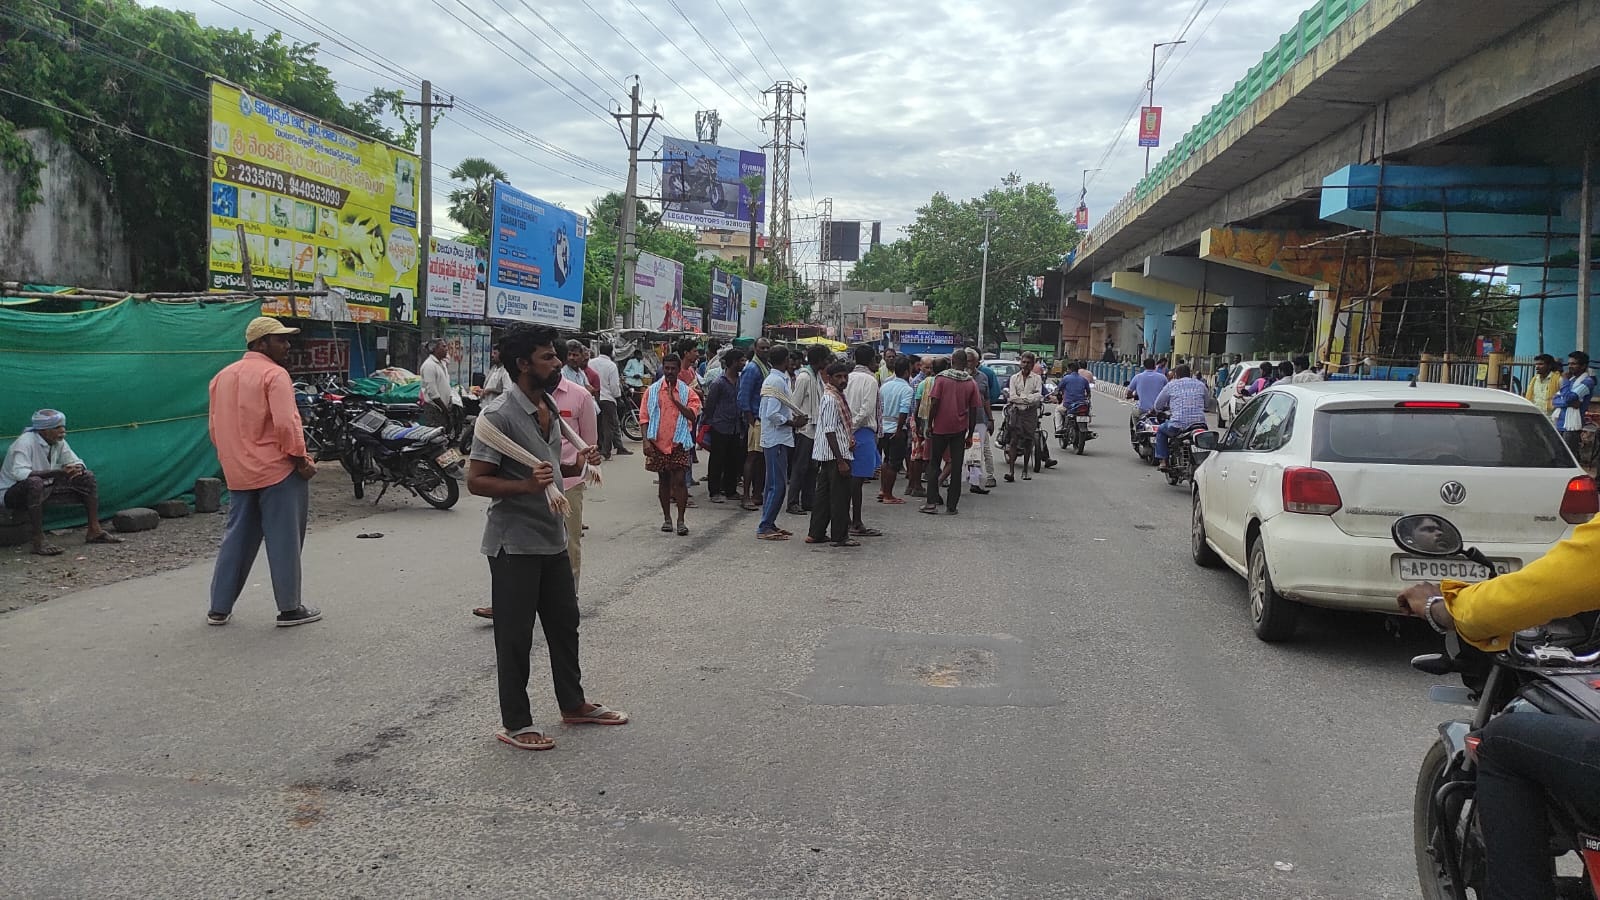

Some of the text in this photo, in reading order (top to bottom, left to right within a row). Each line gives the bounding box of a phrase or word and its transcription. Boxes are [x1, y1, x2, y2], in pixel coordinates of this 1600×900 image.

[238, 164, 340, 206] 2335679, 9440353099
[667, 211, 693, 221] LEGACY
[694, 216, 720, 225] MOTORS
